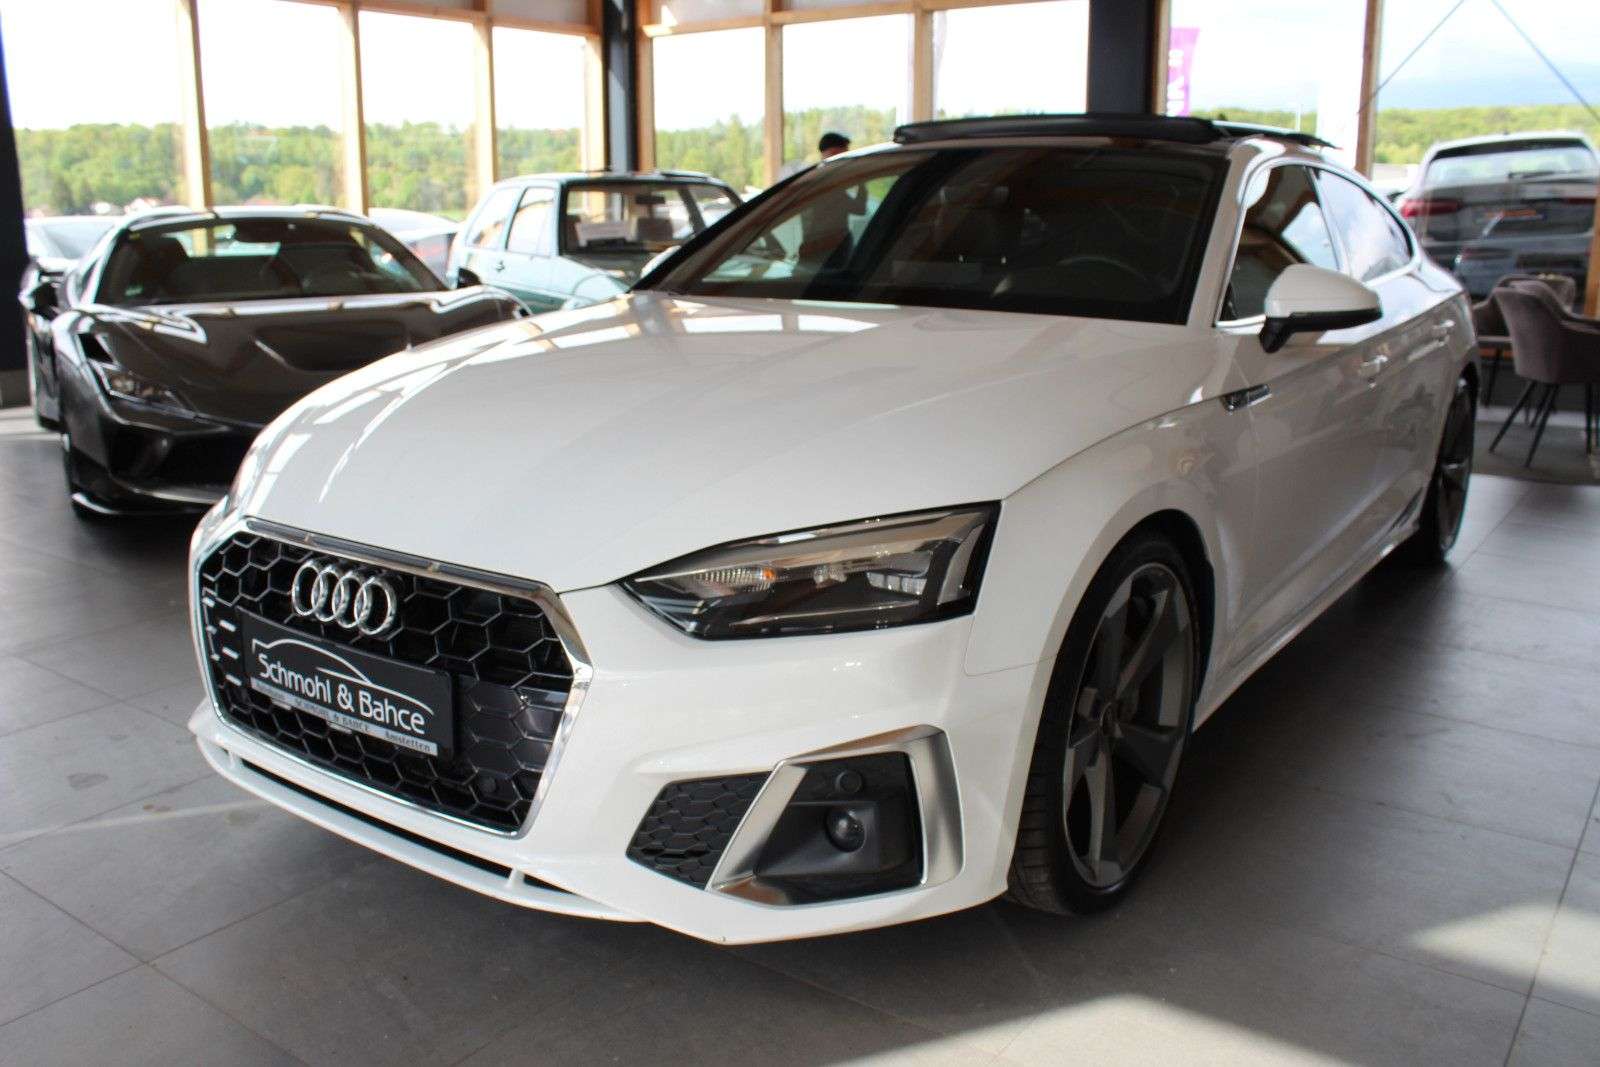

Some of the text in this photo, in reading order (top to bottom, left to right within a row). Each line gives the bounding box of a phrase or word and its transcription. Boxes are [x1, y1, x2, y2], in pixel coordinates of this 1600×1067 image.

[258, 653, 331, 704] Schmohl
[337, 683, 354, 713] &
[359, 690, 425, 735] Bahce
